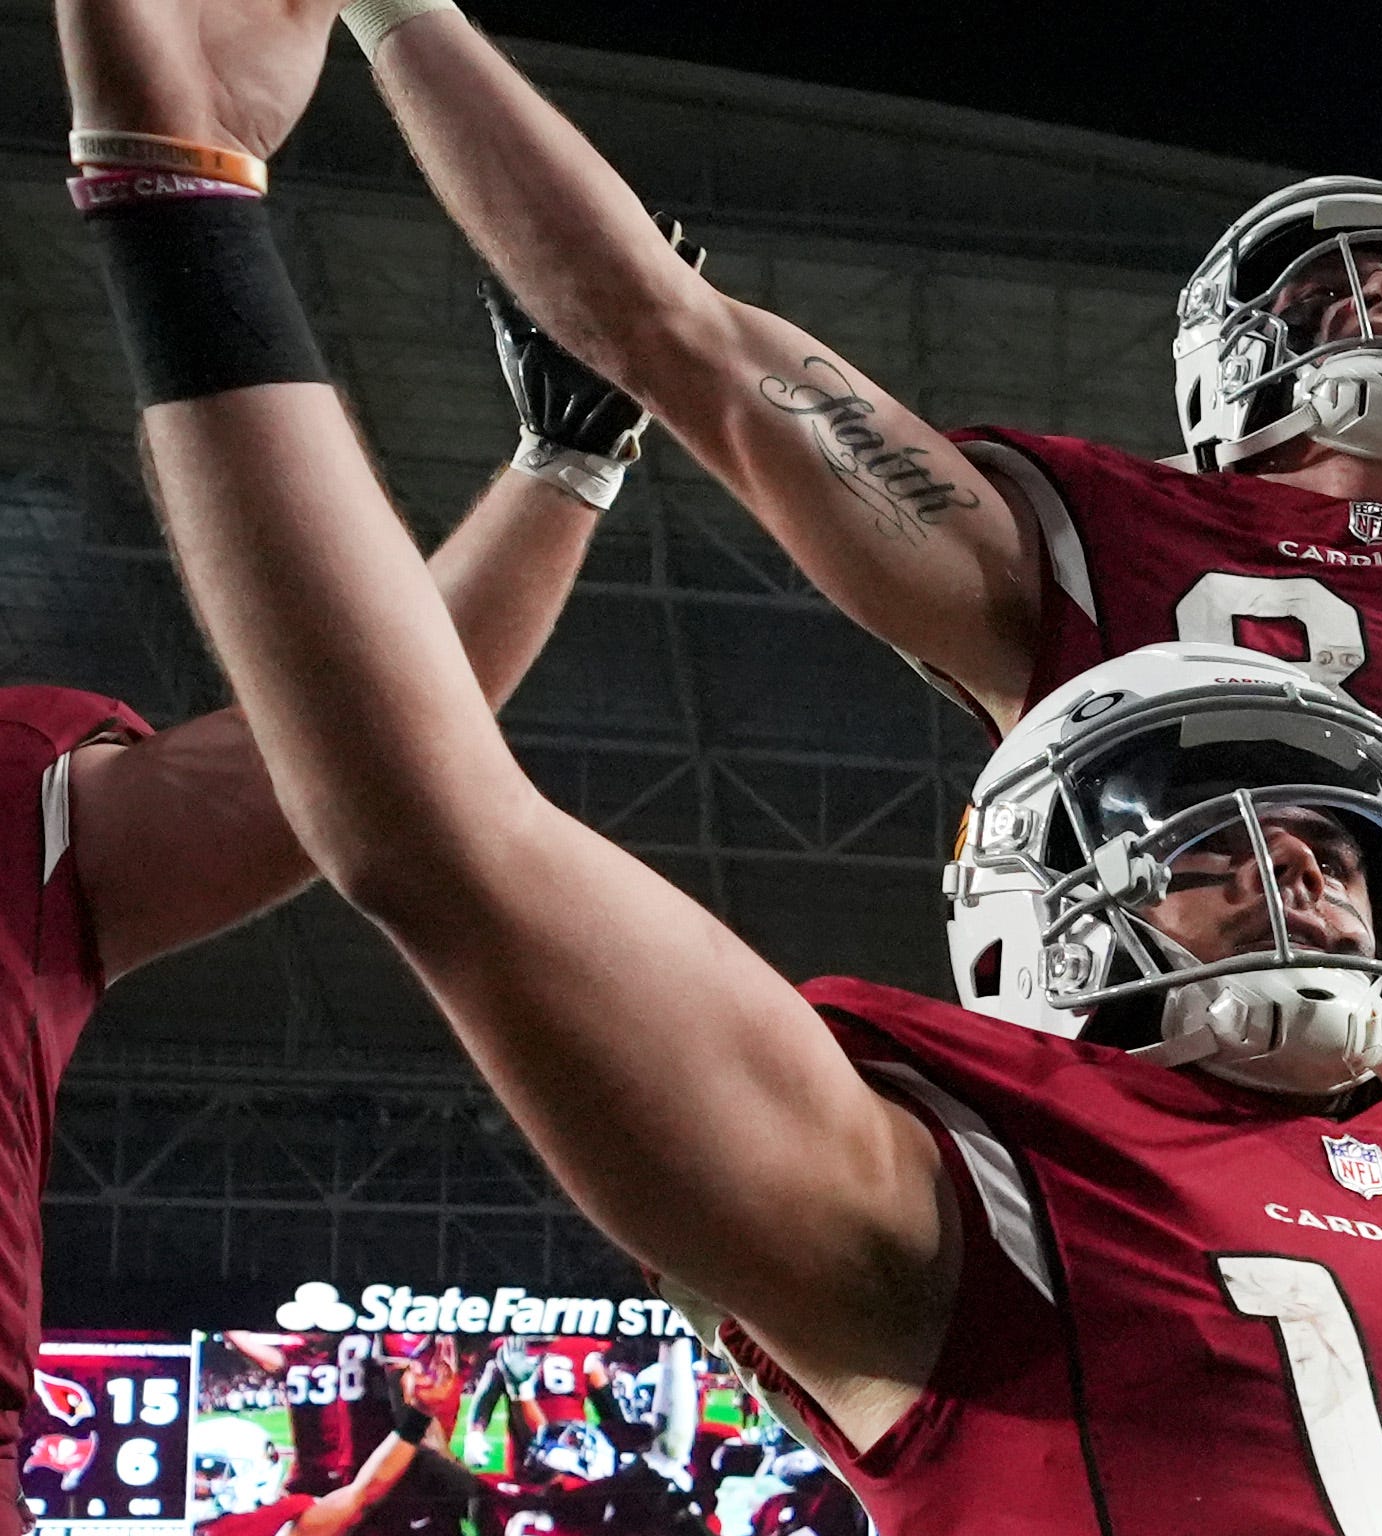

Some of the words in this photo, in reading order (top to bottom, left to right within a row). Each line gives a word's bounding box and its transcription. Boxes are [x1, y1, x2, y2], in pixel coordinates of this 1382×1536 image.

[1340, 1156, 1381, 1187] NFL
[106, 1377, 179, 1426] 15
[286, 1364, 339, 1406] 53
[116, 1437, 159, 1486] 6
